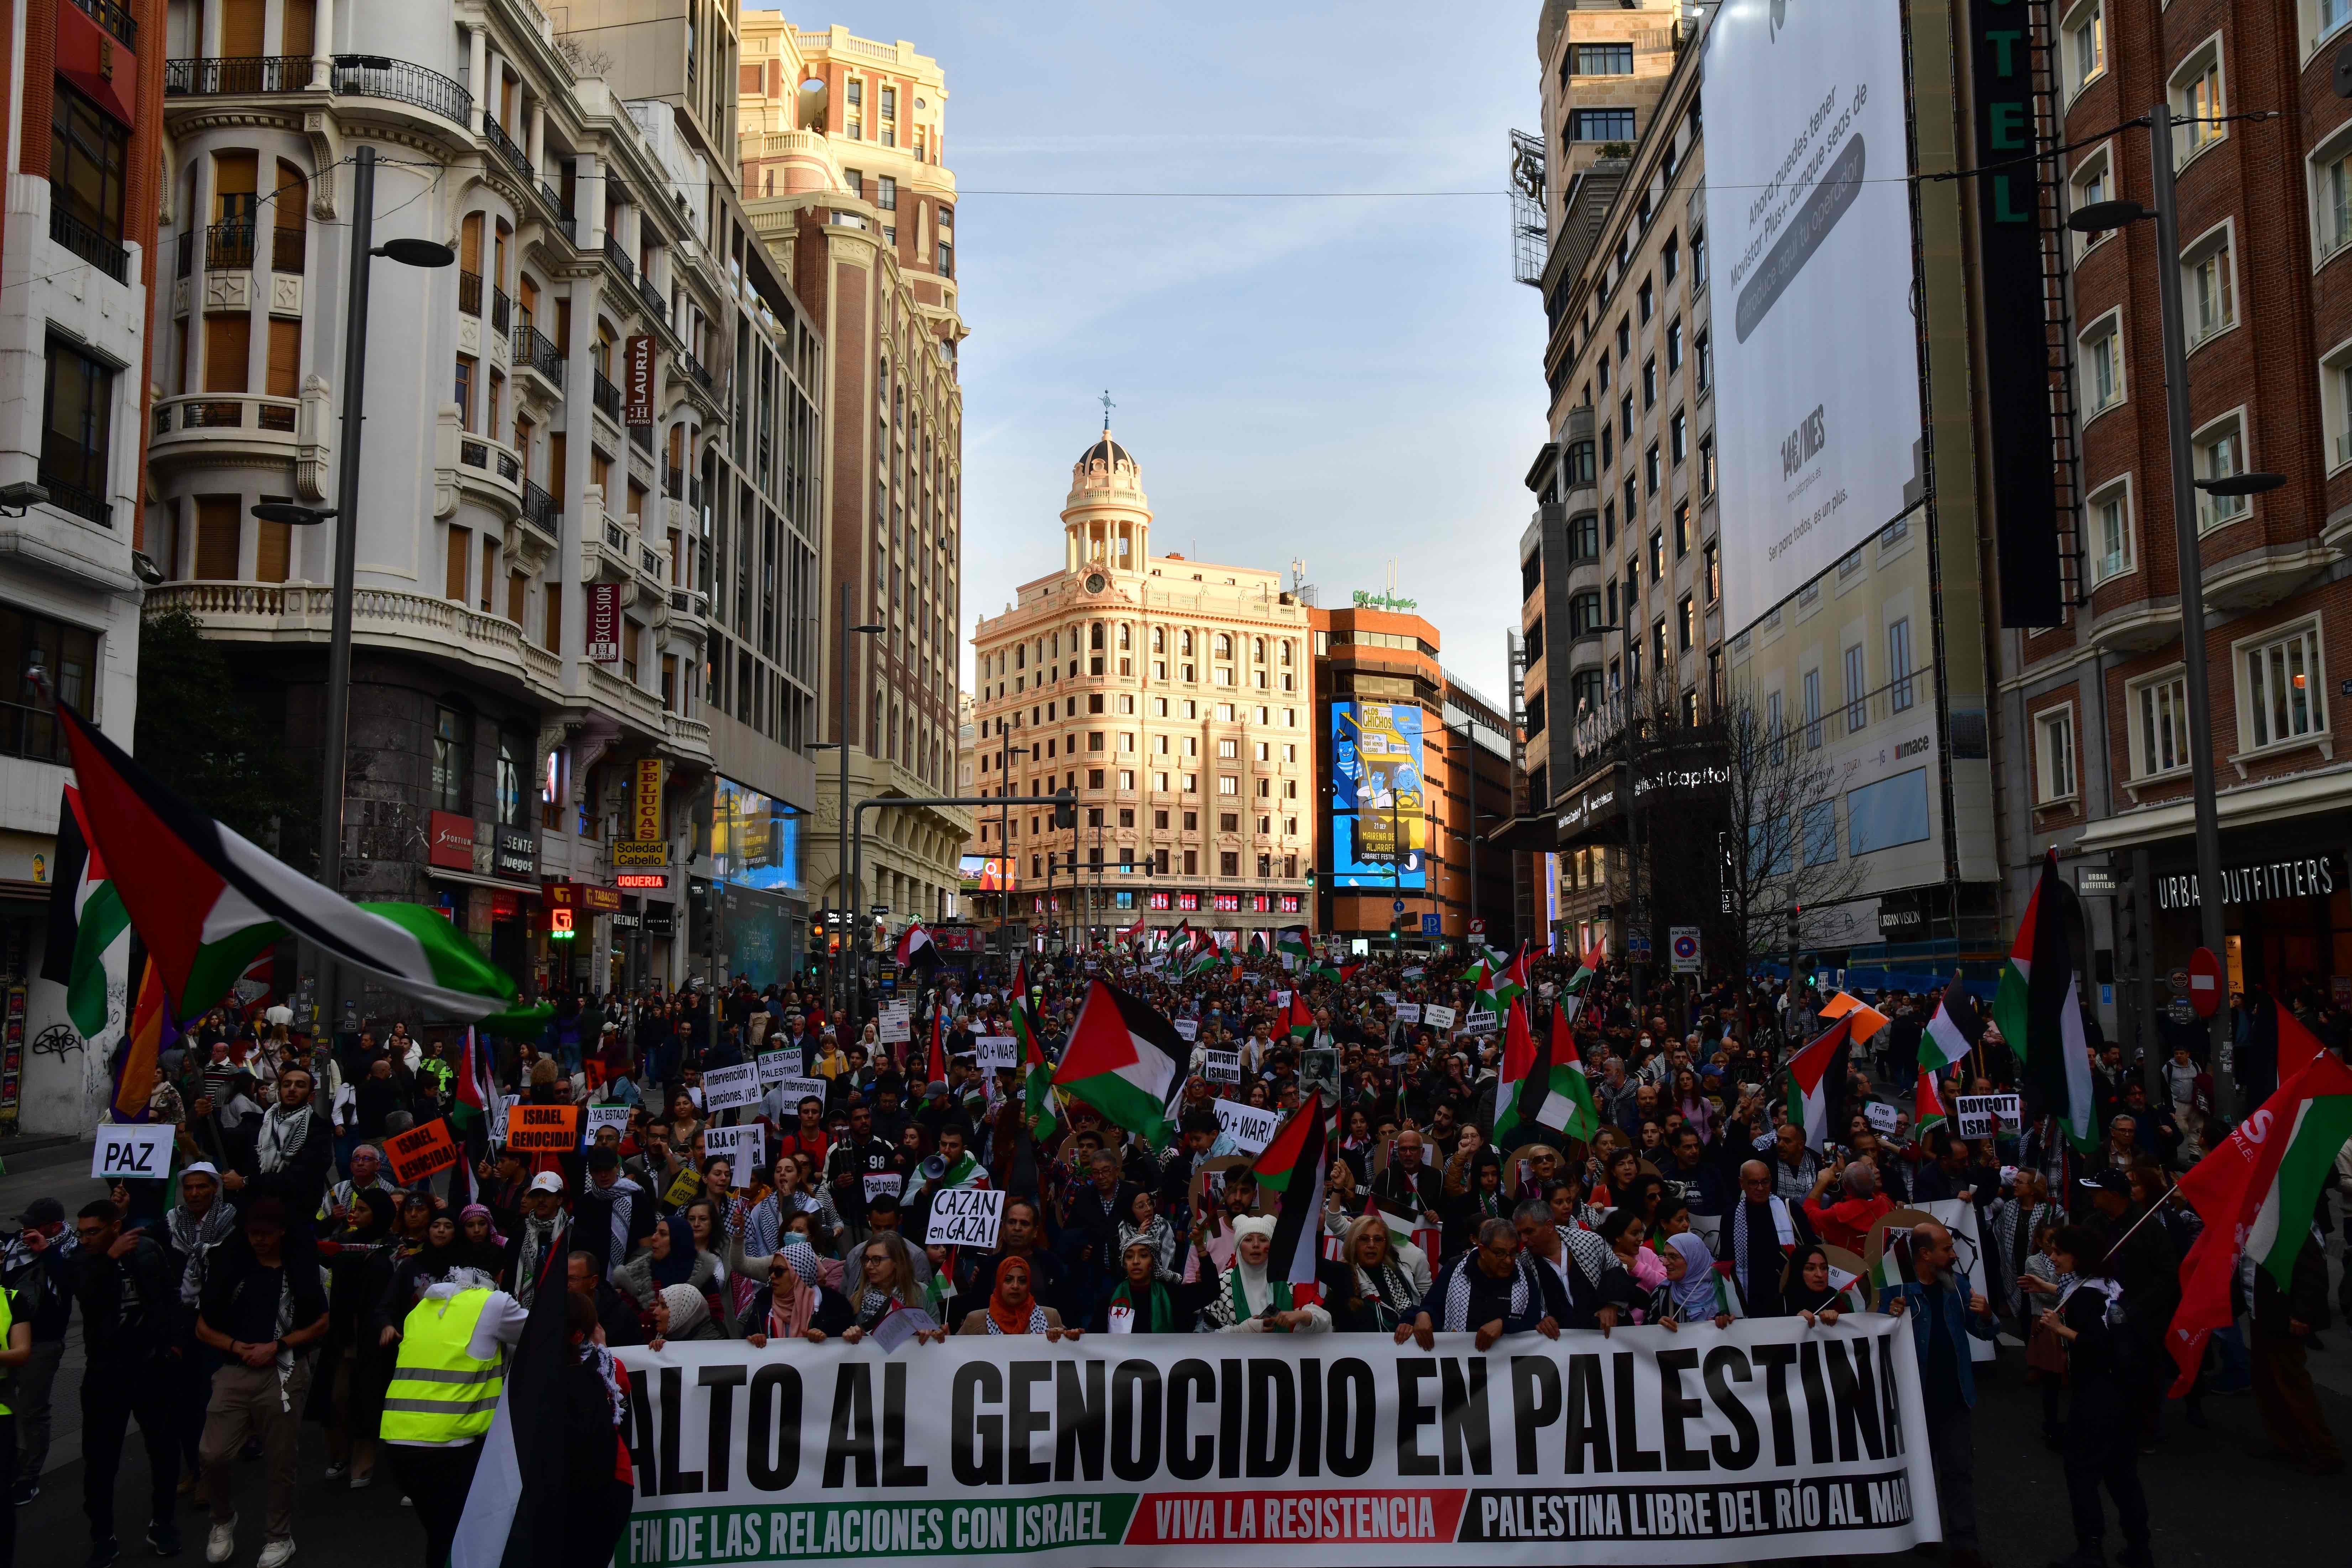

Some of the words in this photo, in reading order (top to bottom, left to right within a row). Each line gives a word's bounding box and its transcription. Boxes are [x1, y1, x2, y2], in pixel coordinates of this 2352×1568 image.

[1749, 183, 1773, 230] Ahora
[1776, 135, 1808, 186] puedes
[1809, 85, 1837, 135] tener
[1731, 236, 1762, 290] Movistar
[1765, 204, 1788, 241] Plus+
[1790, 156, 1824, 203] aunque
[1828, 115, 1850, 153] seas
[1853, 83, 1867, 116] de
[1739, 268, 1776, 327] introduce
[1779, 241, 1798, 278] aquí
[1799, 227, 1809, 248] tu
[1812, 155, 1861, 232] operador
[635, 339, 648, 403] LAURIA
[1780, 403, 1825, 482] 14€/MES
[1787, 467, 1821, 504] movistarplus.es
[1768, 545, 1777, 562] Ser
[1779, 533, 1792, 555] para
[1794, 517, 1812, 542] todos,
[1814, 512, 1821, 525] es
[1823, 502, 1830, 517] un
[1832, 488, 1848, 515] plus.
[595, 587, 612, 642] EXCELSIOR
[1363, 710, 1391, 728] CHICHOS
[1903, 735, 1928, 756] mace
[1668, 766, 1730, 788] Capitol
[639, 761, 657, 839] PELUCAS
[436, 829, 470, 845] SPORTIUM
[507, 835, 532, 853] SENTE
[1363, 832, 1386, 840] MAIRENA
[618, 844, 662, 853] Soledad
[1366, 843, 1394, 852] ALJARAFE
[502, 855, 532, 872] Juegos
[619, 855, 661, 865] Cabello
[618, 876, 662, 886] UQUERIA
[2081, 881, 2116, 889] OUTFITTERS
[2159, 875, 2200, 909] URBA
[2221, 857, 2332, 905] OUTFITTERS
[595, 890, 618, 903] TABACOS
[614, 914, 638, 927] DECIMAS
[1880, 913, 1899, 927] URBAN
[1899, 910, 1920, 925] VISION
[299, 1003, 312, 1012] TM54
[1429, 1012, 1450, 1021] PALESTINA
[1468, 1012, 1495, 1021] BOYCOTT
[1470, 1023, 1496, 1032] ISRAEL!!!
[758, 1054, 771, 1067] ¡YA,
[773, 1050, 801, 1064] ESTADO
[977, 1048, 989, 1061] NO
[997, 1044, 1016, 1060] WAR!
[1208, 1051, 1238, 1064] BOYCOTT
[707, 1068, 747, 1087] Intervención
[749, 1068, 754, 1080] y
[761, 1064, 800, 1078] PALESTINO!
[1208, 1066, 1238, 1080] ISRAEL!!!
[784, 1082, 817, 1093] Intervención
[819, 1085, 823, 1094] y
[709, 1091, 744, 1106] sanciones,
[745, 1088, 758, 1103] ¡ya!
[1875, 1105, 1890, 1116] Free
[1960, 1098, 2016, 1114] BOYCOTT
[523, 1109, 565, 1125] ISRAEL,
[589, 1110, 604, 1123] ¡YA,
[605, 1109, 629, 1121] ESTADO
[396, 1127, 438, 1154] ISRAEL,
[512, 1130, 574, 1147] GENOCIDA!
[707, 1130, 730, 1148] U.S.A.
[105, 1143, 155, 1171] PAZ
[399, 1145, 457, 1181] GENOCIDA!
[869, 1155, 885, 1168] 98
[865, 1181, 880, 1193] Pact
[882, 1177, 901, 1194] peace!
[934, 1189, 998, 1216] CAZAN
[930, 1226, 943, 1239] en
[948, 1216, 996, 1247] GAZA!
[630, 1363, 803, 1497] ALTO
[822, 1362, 928, 1488] AL
[952, 1357, 1376, 1486] GENOCIDIO
[1397, 1355, 1492, 1476] EN
[1511, 1334, 1906, 1475] PALESTINA
[1481, 1493, 1623, 1537] PALESTINA
[1628, 1490, 1710, 1535] LIBRE
[1718, 1488, 1769, 1533] DEL
[1776, 1478, 1819, 1531] RÍO
[1828, 1483, 1863, 1525] AL
[1155, 1498, 1215, 1541] VIVA
[1223, 1497, 1255, 1540] LA
[1261, 1496, 1435, 1539] RESISTENCIA
[630, 1518, 661, 1564] FIN
[669, 1516, 704, 1561] DE
[710, 1511, 762, 1557] LAS
[770, 1506, 942, 1554] RELACIONES
[951, 1505, 1008, 1550] CON
[1015, 1500, 1106, 1548] ISRAEL
